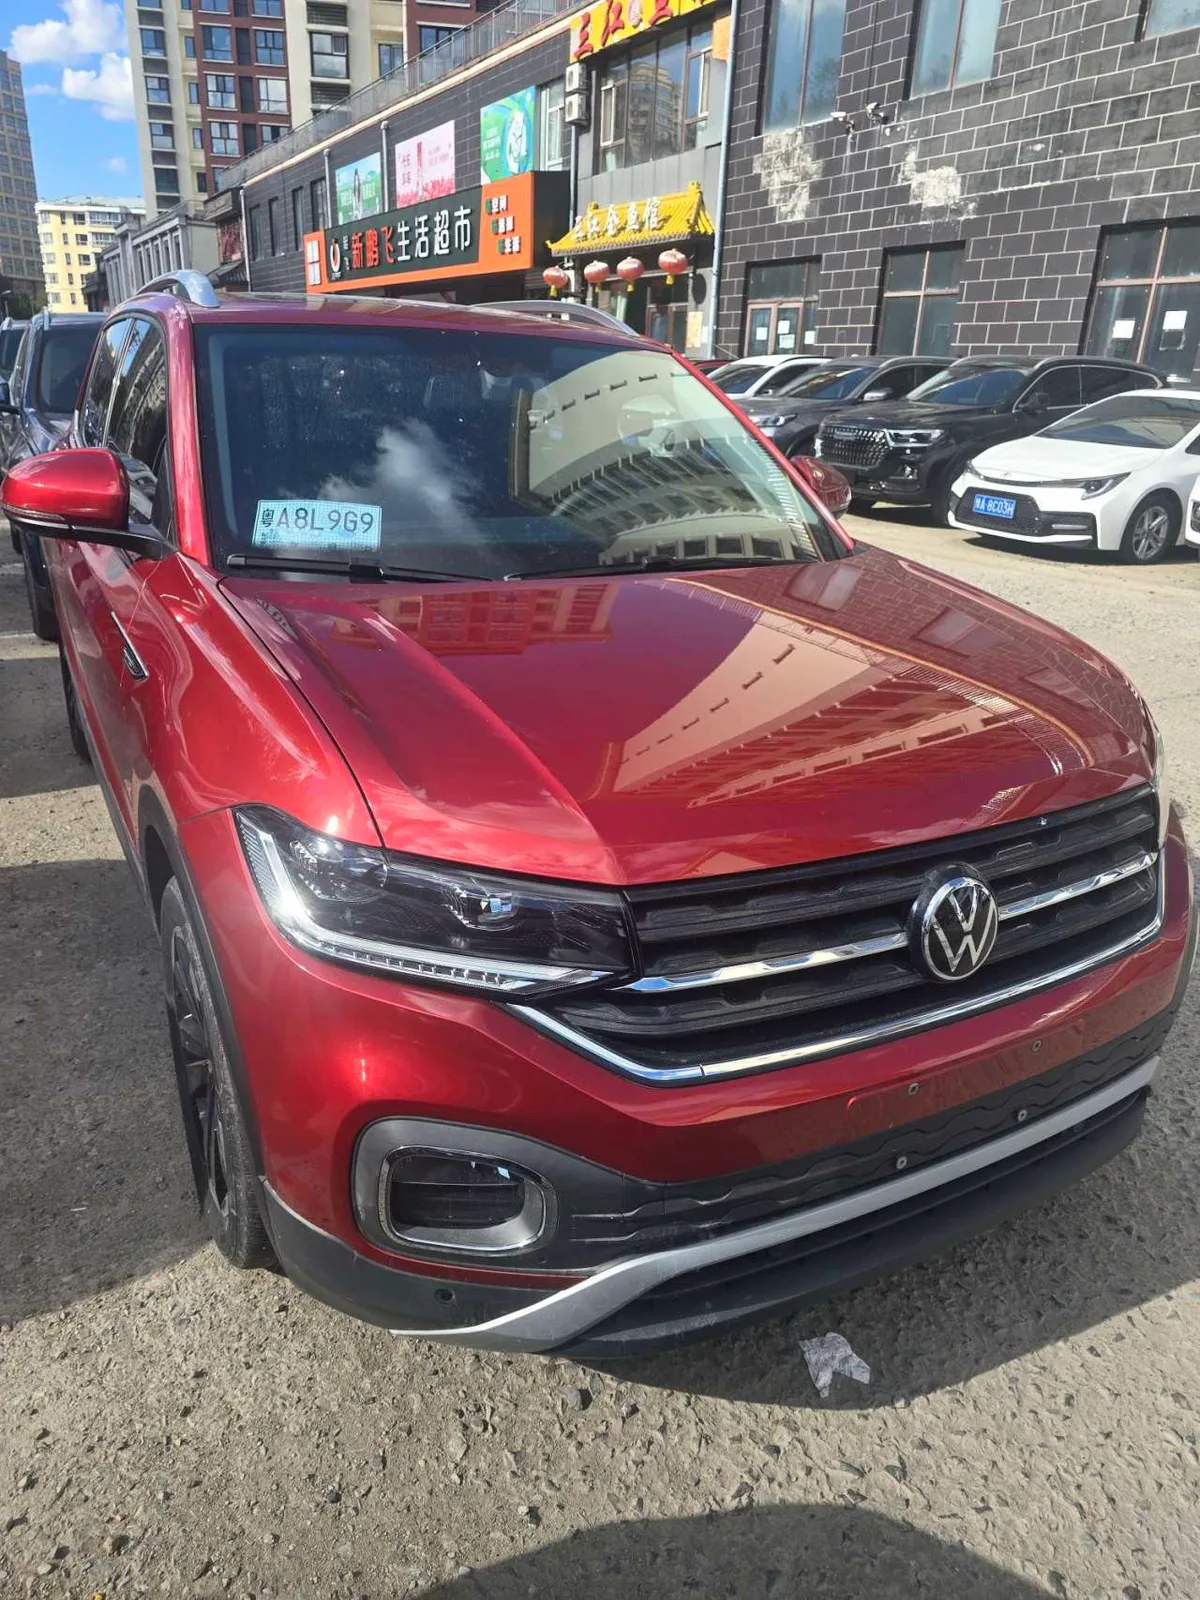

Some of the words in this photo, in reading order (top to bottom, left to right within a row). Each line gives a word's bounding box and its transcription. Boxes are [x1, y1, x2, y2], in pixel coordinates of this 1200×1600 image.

[351, 205, 472, 269] 新鹏飞生活超市
[260, 507, 374, 534] 粤A8L9G9
